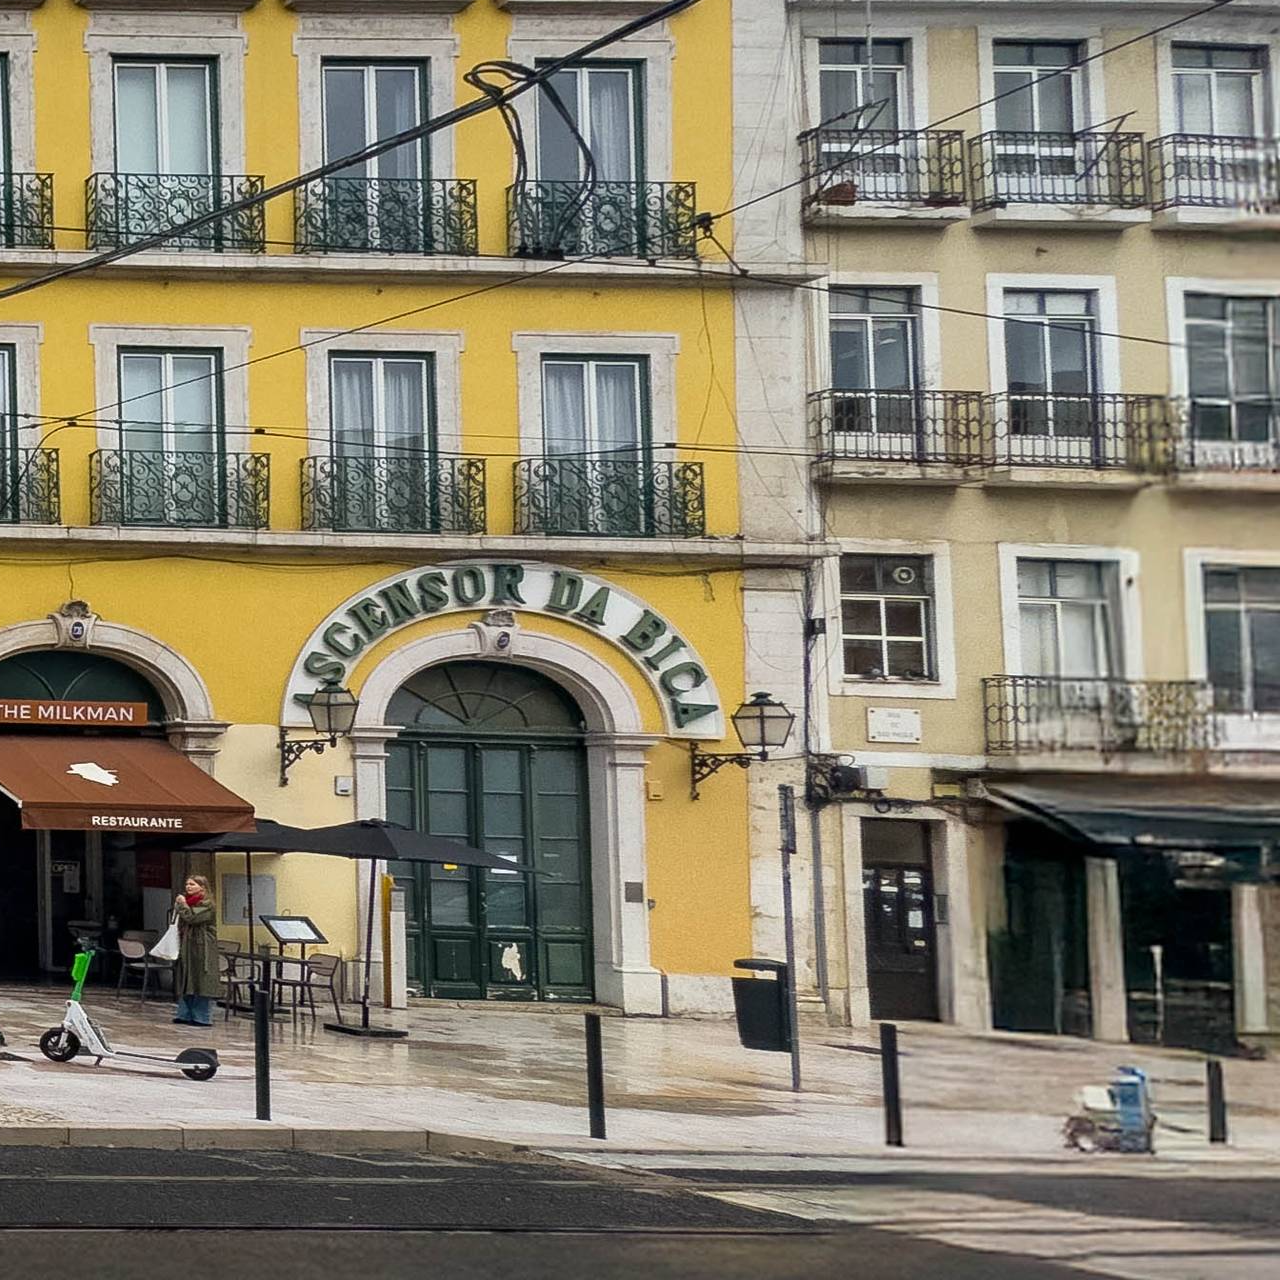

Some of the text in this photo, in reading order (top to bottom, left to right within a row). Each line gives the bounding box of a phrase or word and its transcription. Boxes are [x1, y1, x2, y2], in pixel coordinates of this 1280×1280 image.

[293, 563, 719, 728] SCENSOR DA BICA
[38, 705, 134, 721] MILKMAN
[91, 816, 183, 828] RESTAURANTE
